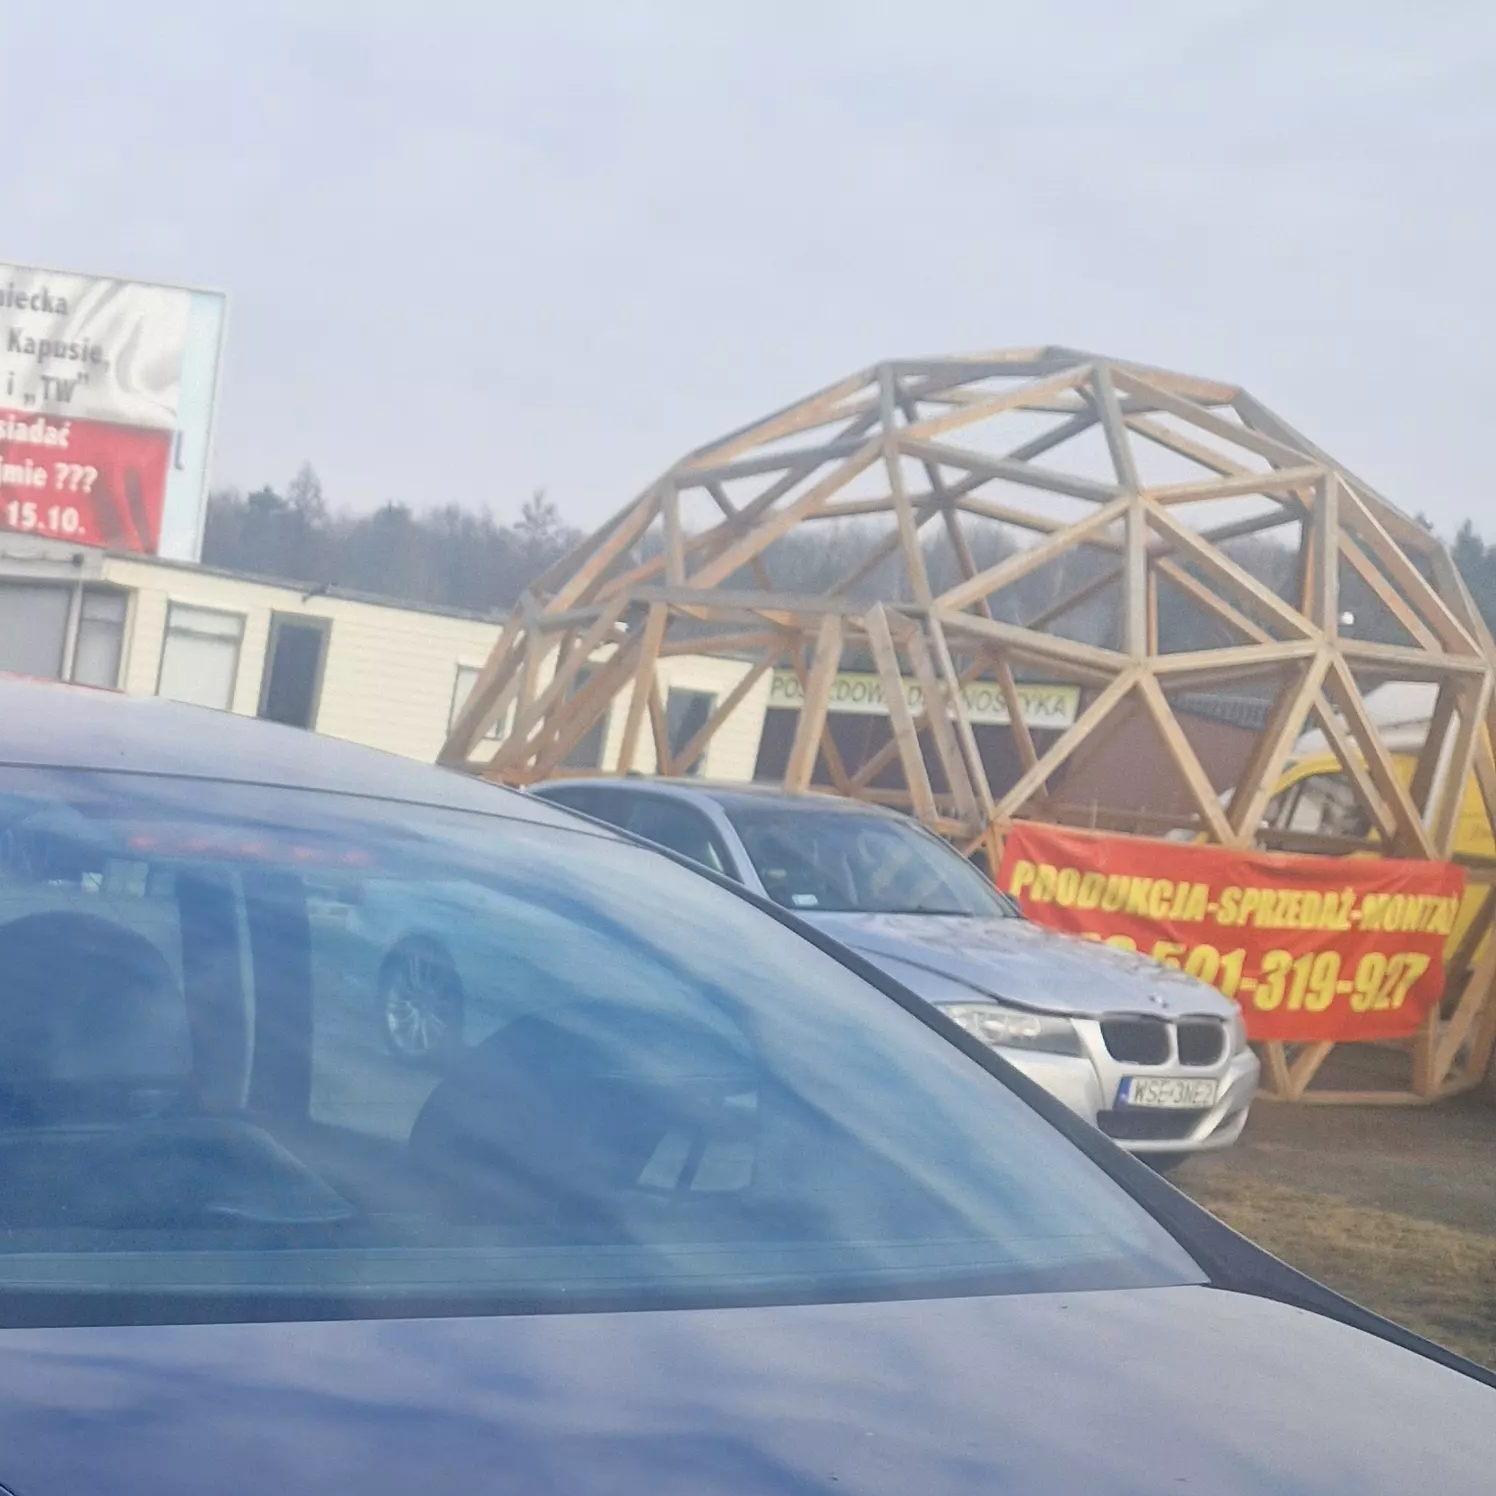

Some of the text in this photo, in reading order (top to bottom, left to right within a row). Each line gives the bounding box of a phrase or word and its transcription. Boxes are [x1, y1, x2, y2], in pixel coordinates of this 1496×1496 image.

[7, 372, 15, 395] i
[54, 462, 98, 493] ???
[8, 501, 85, 534] 15.10.
